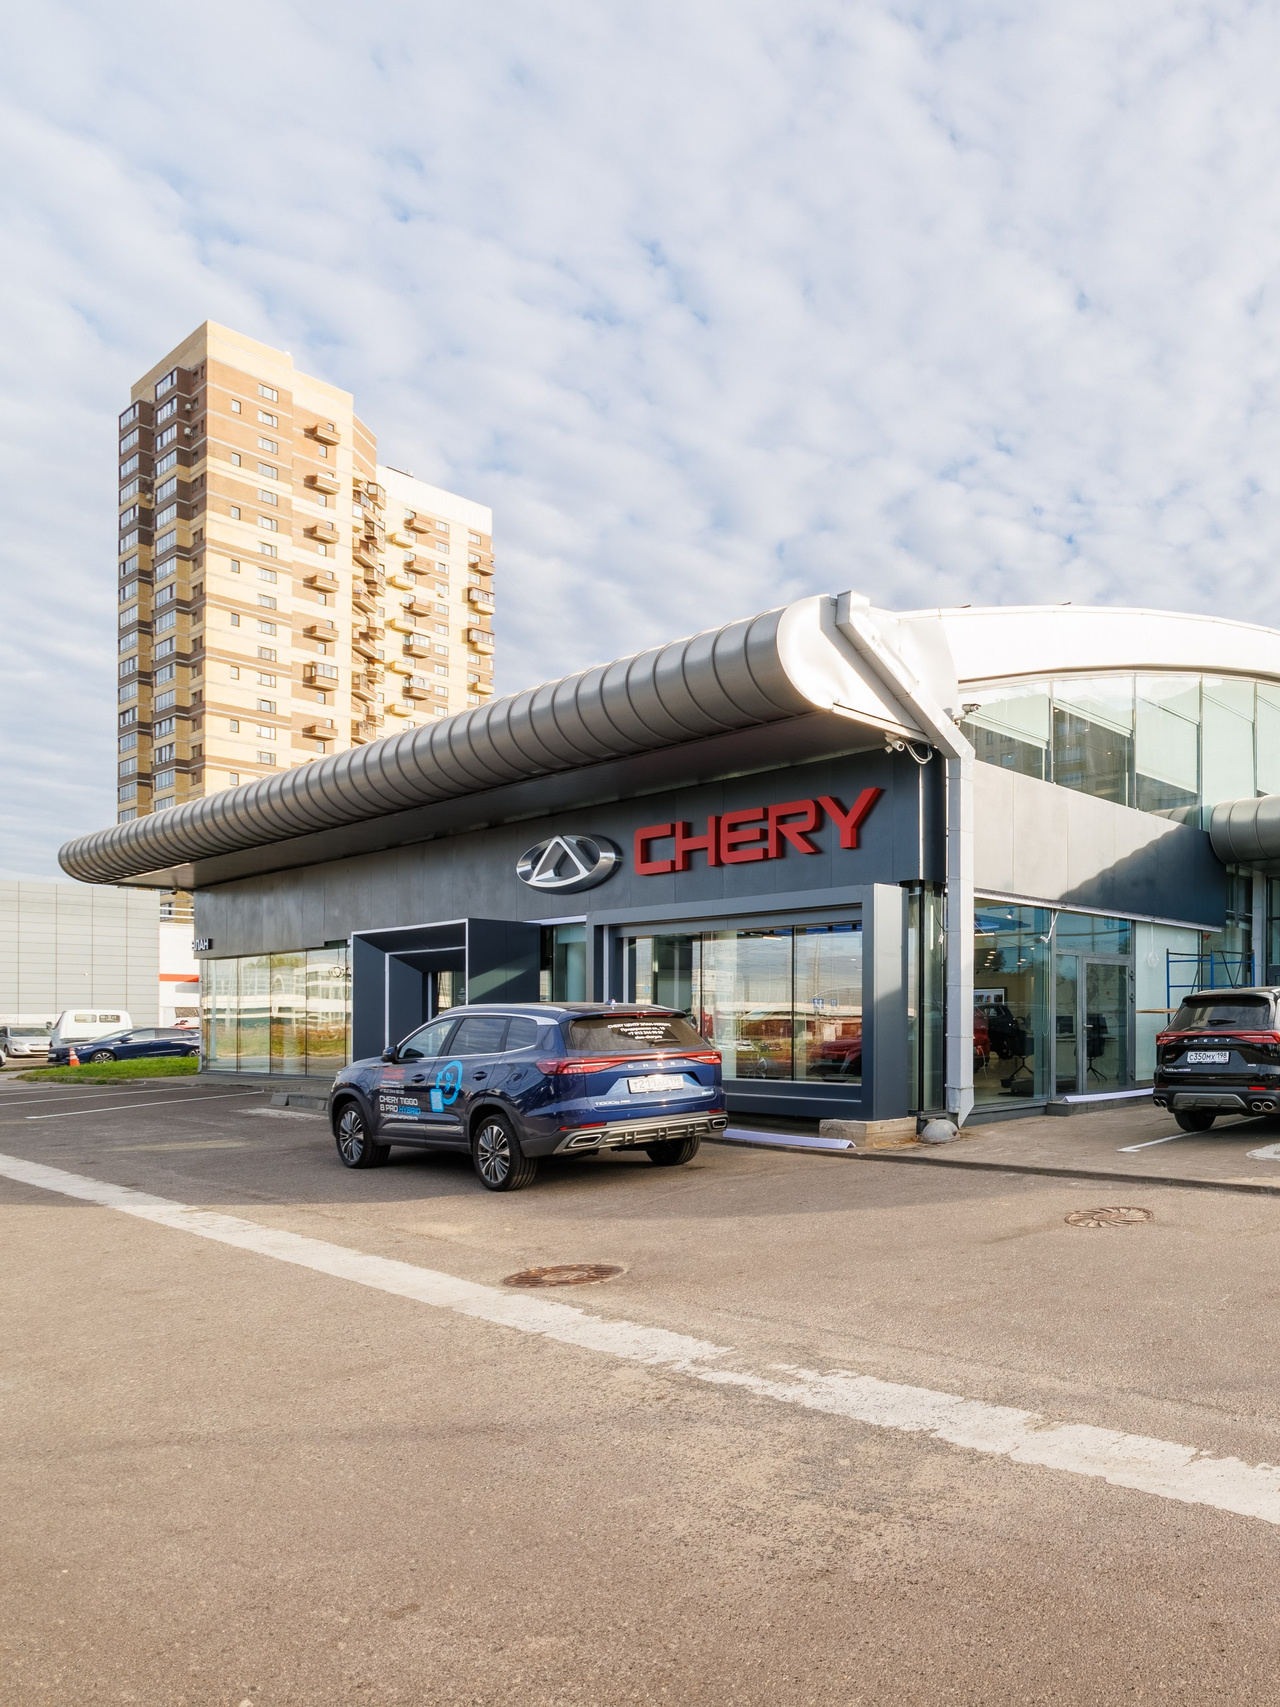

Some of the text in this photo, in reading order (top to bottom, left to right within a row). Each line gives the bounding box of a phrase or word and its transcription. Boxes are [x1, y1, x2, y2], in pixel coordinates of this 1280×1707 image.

[633, 787, 881, 876] CHERY
[379, 1095, 419, 1106] CHERY TIGGO
[380, 1103, 421, 1115] 8 PRO HYBRID
